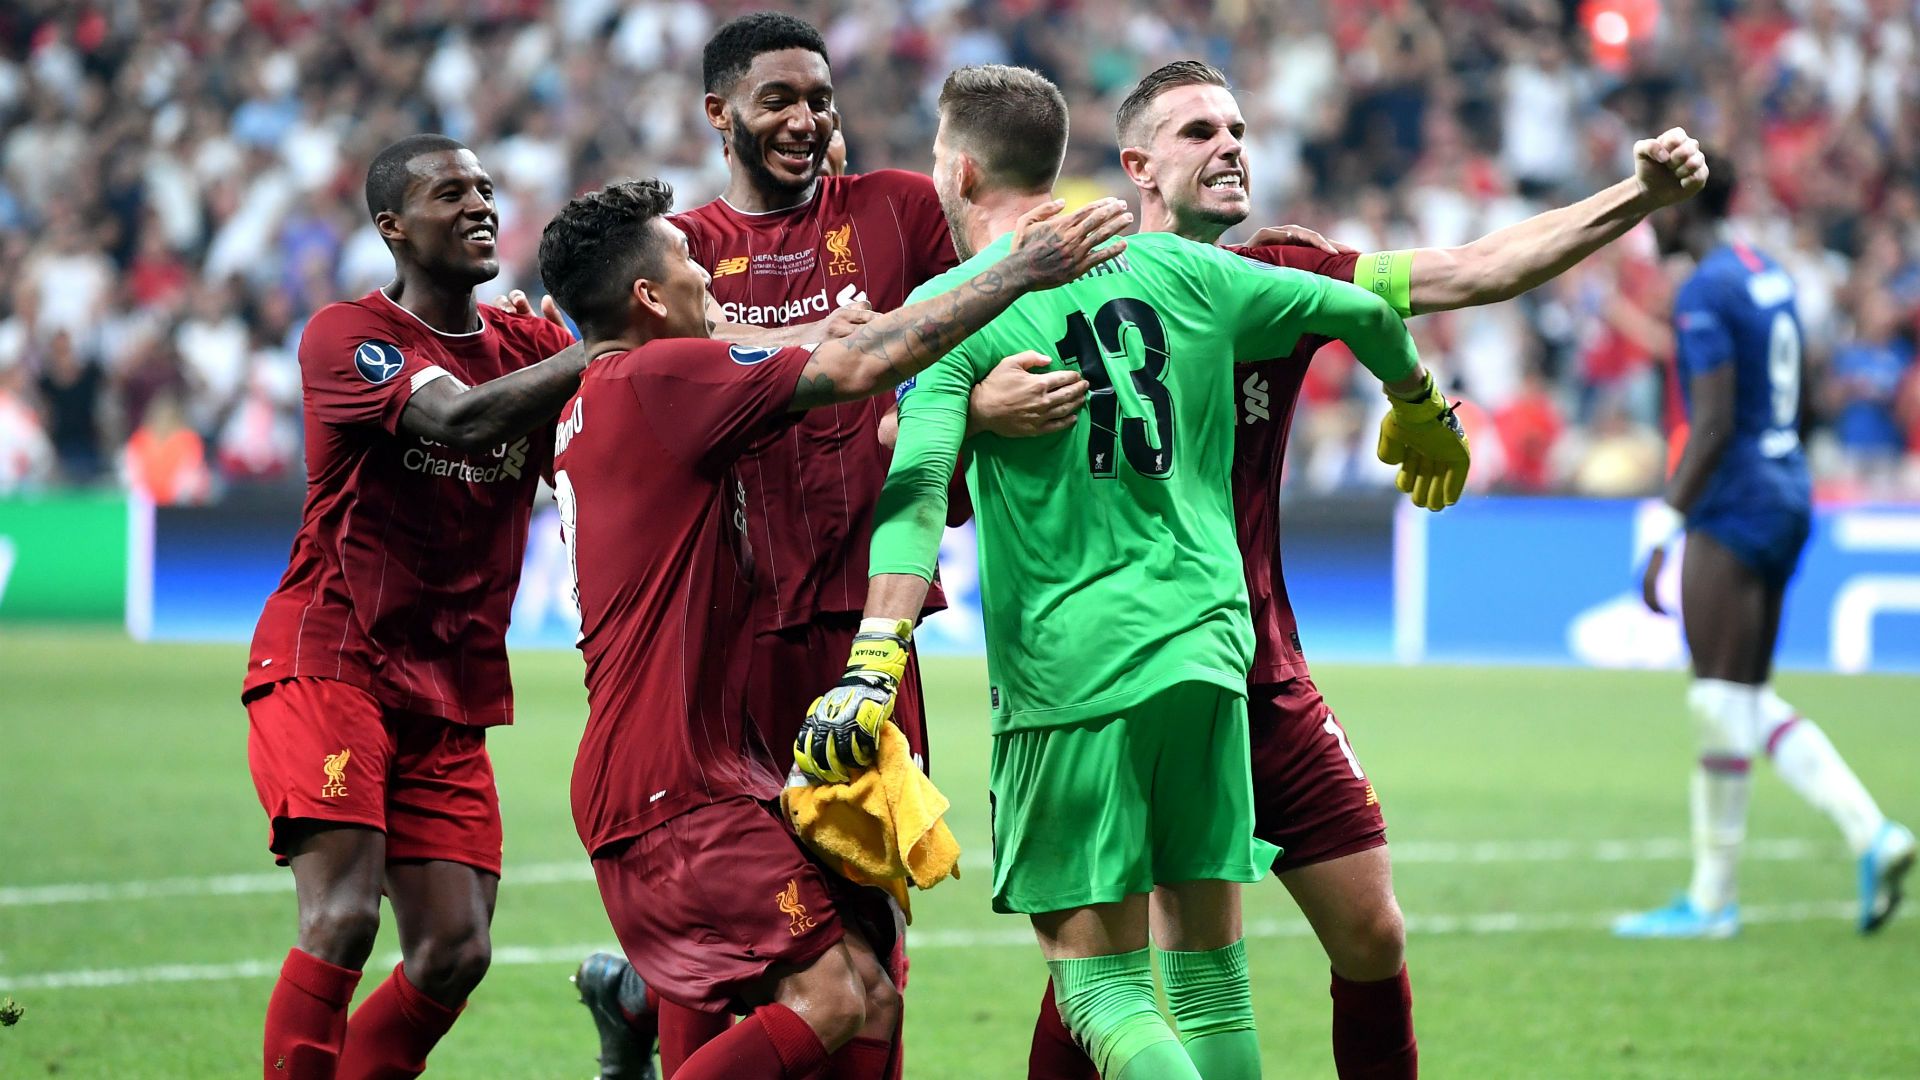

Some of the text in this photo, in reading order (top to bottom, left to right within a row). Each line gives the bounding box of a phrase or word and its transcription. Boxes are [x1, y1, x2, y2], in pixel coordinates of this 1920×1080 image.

[752, 254, 773, 262] UEFA
[721, 288, 829, 324] Standard
[1055, 297, 1176, 480] 13
[403, 448, 501, 483] Chartered
[855, 649, 889, 658] ADRIAN
